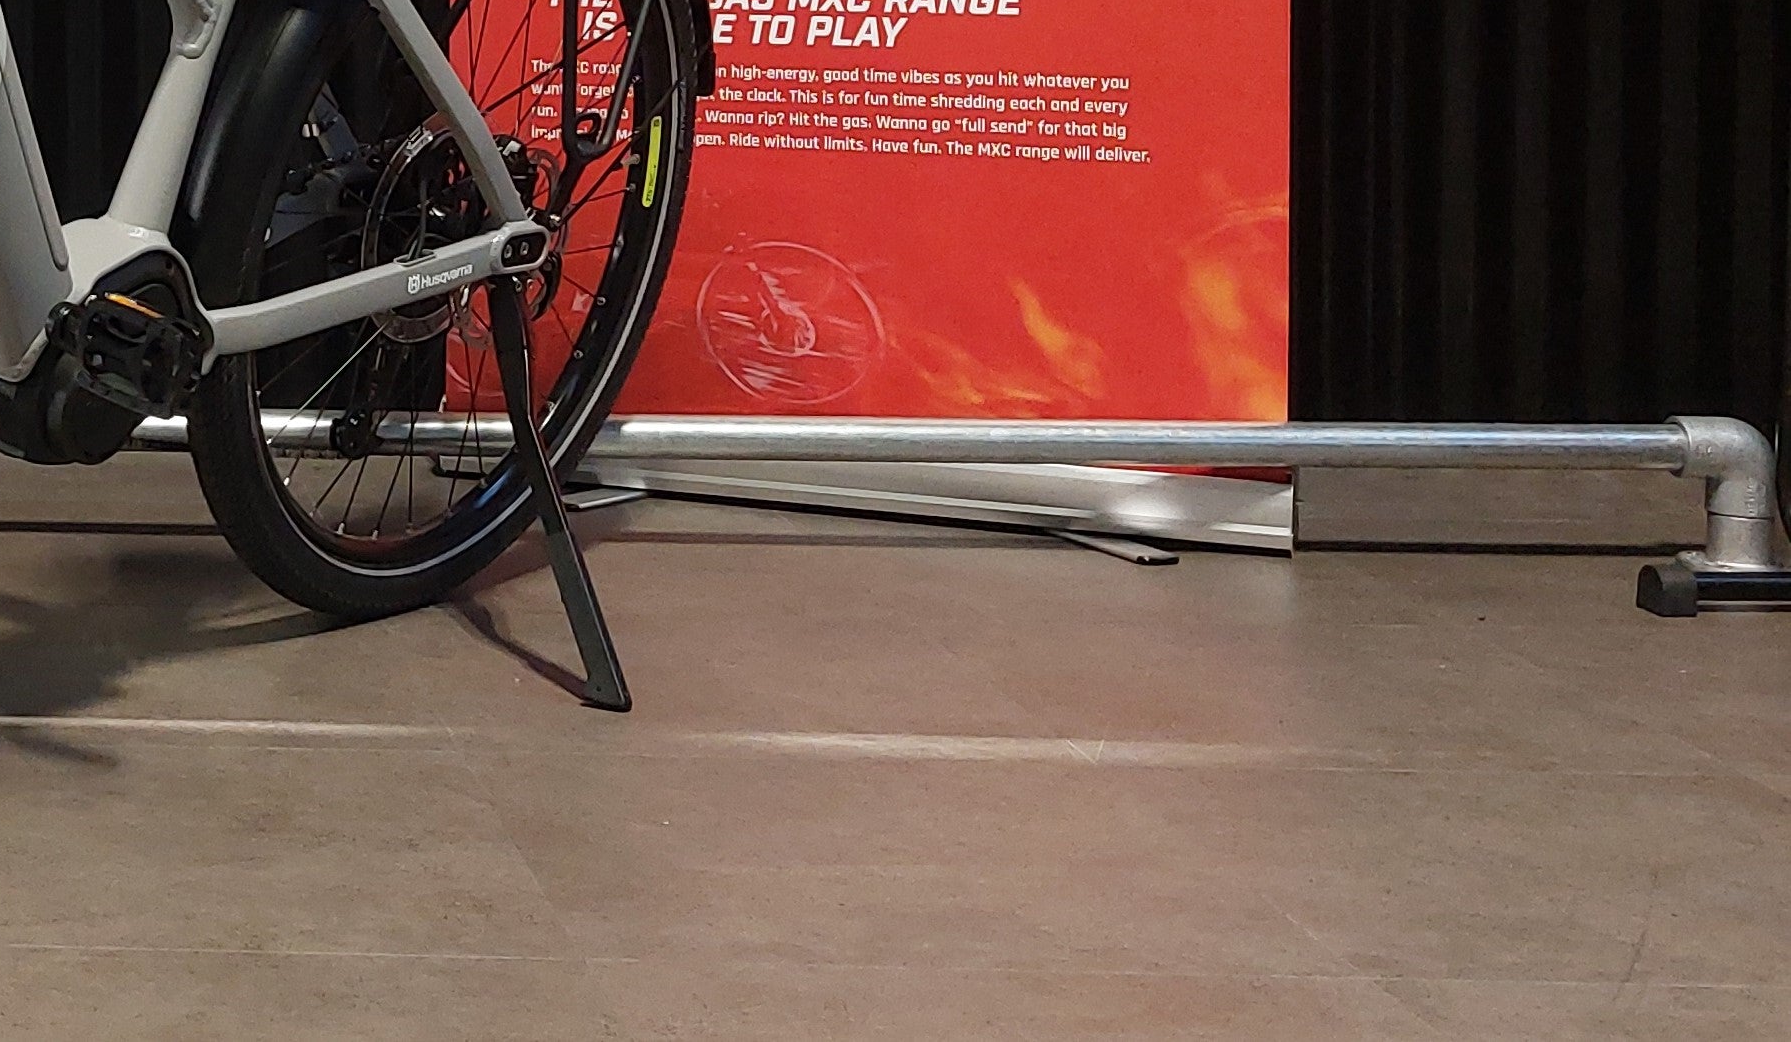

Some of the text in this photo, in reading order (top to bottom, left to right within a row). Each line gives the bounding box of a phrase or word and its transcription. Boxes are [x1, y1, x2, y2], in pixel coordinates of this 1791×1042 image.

[748, 15, 795, 45] TO
[806, 16, 908, 47] PLAY
[731, 64, 819, 83] high-energy,
[823, 68, 859, 84] good
[862, 68, 897, 83] time
[900, 68, 940, 84] vibes
[944, 72, 962, 84] as
[965, 73, 994, 88] you
[998, 70, 1019, 87] hit
[1023, 73, 1097, 90] whatever
[1101, 76, 1130, 92] you
[718, 87, 743, 101] the
[746, 88, 786, 102] clock.
[789, 90, 818, 104] This
[821, 90, 834, 104] is
[838, 91, 860, 105] for
[864, 92, 888, 106] fun
[892, 92, 927, 107] time
[930, 94, 1005, 112] shredding
[1010, 97, 1045, 111] each
[1050, 98, 1079, 112] and
[1084, 100, 1128, 116] every
[705, 109, 754, 124] Wanna
[757, 111, 785, 126] rip?
[789, 112, 810, 125] Hit
[813, 113, 838, 127] the
[842, 116, 872, 130] gas.
[875, 114, 927, 130] Wanna
[932, 118, 950, 133] go
[1037, 120, 1061, 135] for
[1064, 121, 1098, 137] that
[1102, 122, 1127, 140] big
[729, 133, 760, 146] Ride
[763, 134, 820, 149] without
[823, 136, 868, 152] limits.
[872, 138, 908, 153] Have
[912, 139, 942, 154] fun.
[946, 141, 973, 156] The
[978, 141, 1011, 157] MXC
[1015, 145, 1060, 161] range
[1064, 145, 1090, 161] will
[1095, 147, 1151, 163] deliver.
[420, 264, 473, 289] Husqvarna
